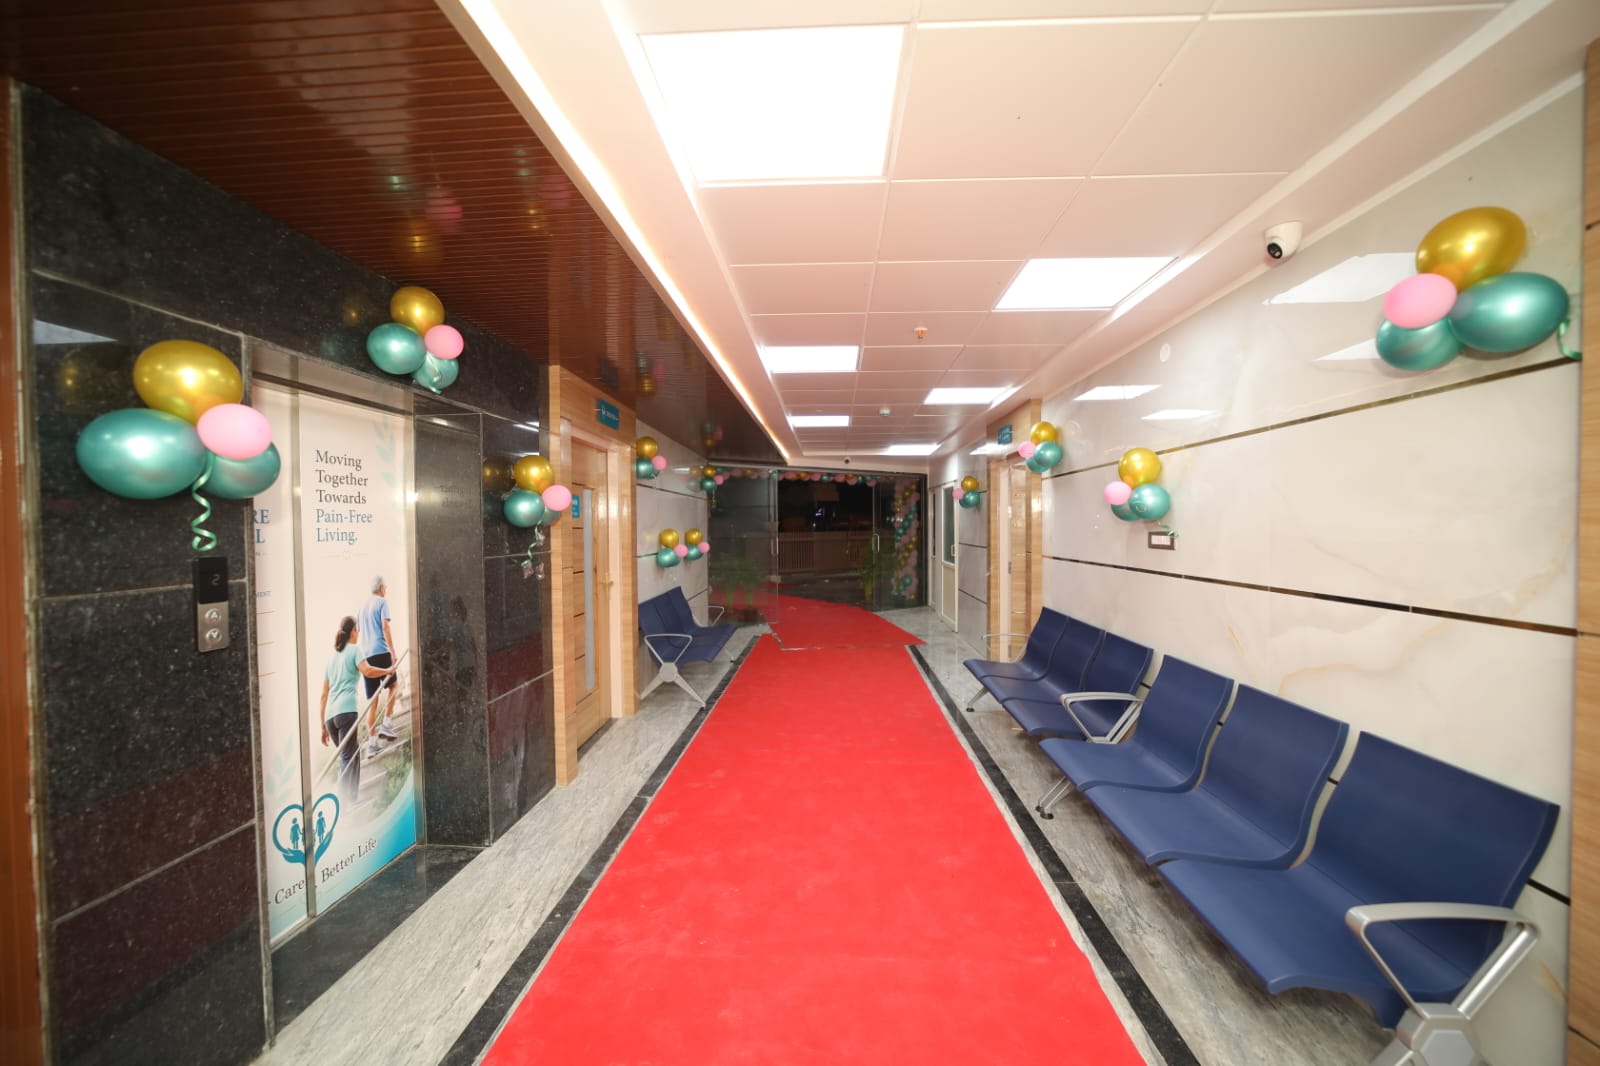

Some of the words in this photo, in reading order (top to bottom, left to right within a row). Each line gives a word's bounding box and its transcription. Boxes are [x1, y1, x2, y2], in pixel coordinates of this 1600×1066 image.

[315, 449, 362, 472] Moving
[315, 469, 369, 488] Together
[315, 489, 367, 505] Towards
[316, 508, 373, 524] Pain-Free
[316, 527, 358, 545] Living.
[210, 573, 221, 586] 2
[320, 853, 355, 884] Better
[357, 838, 377, 859] Life
